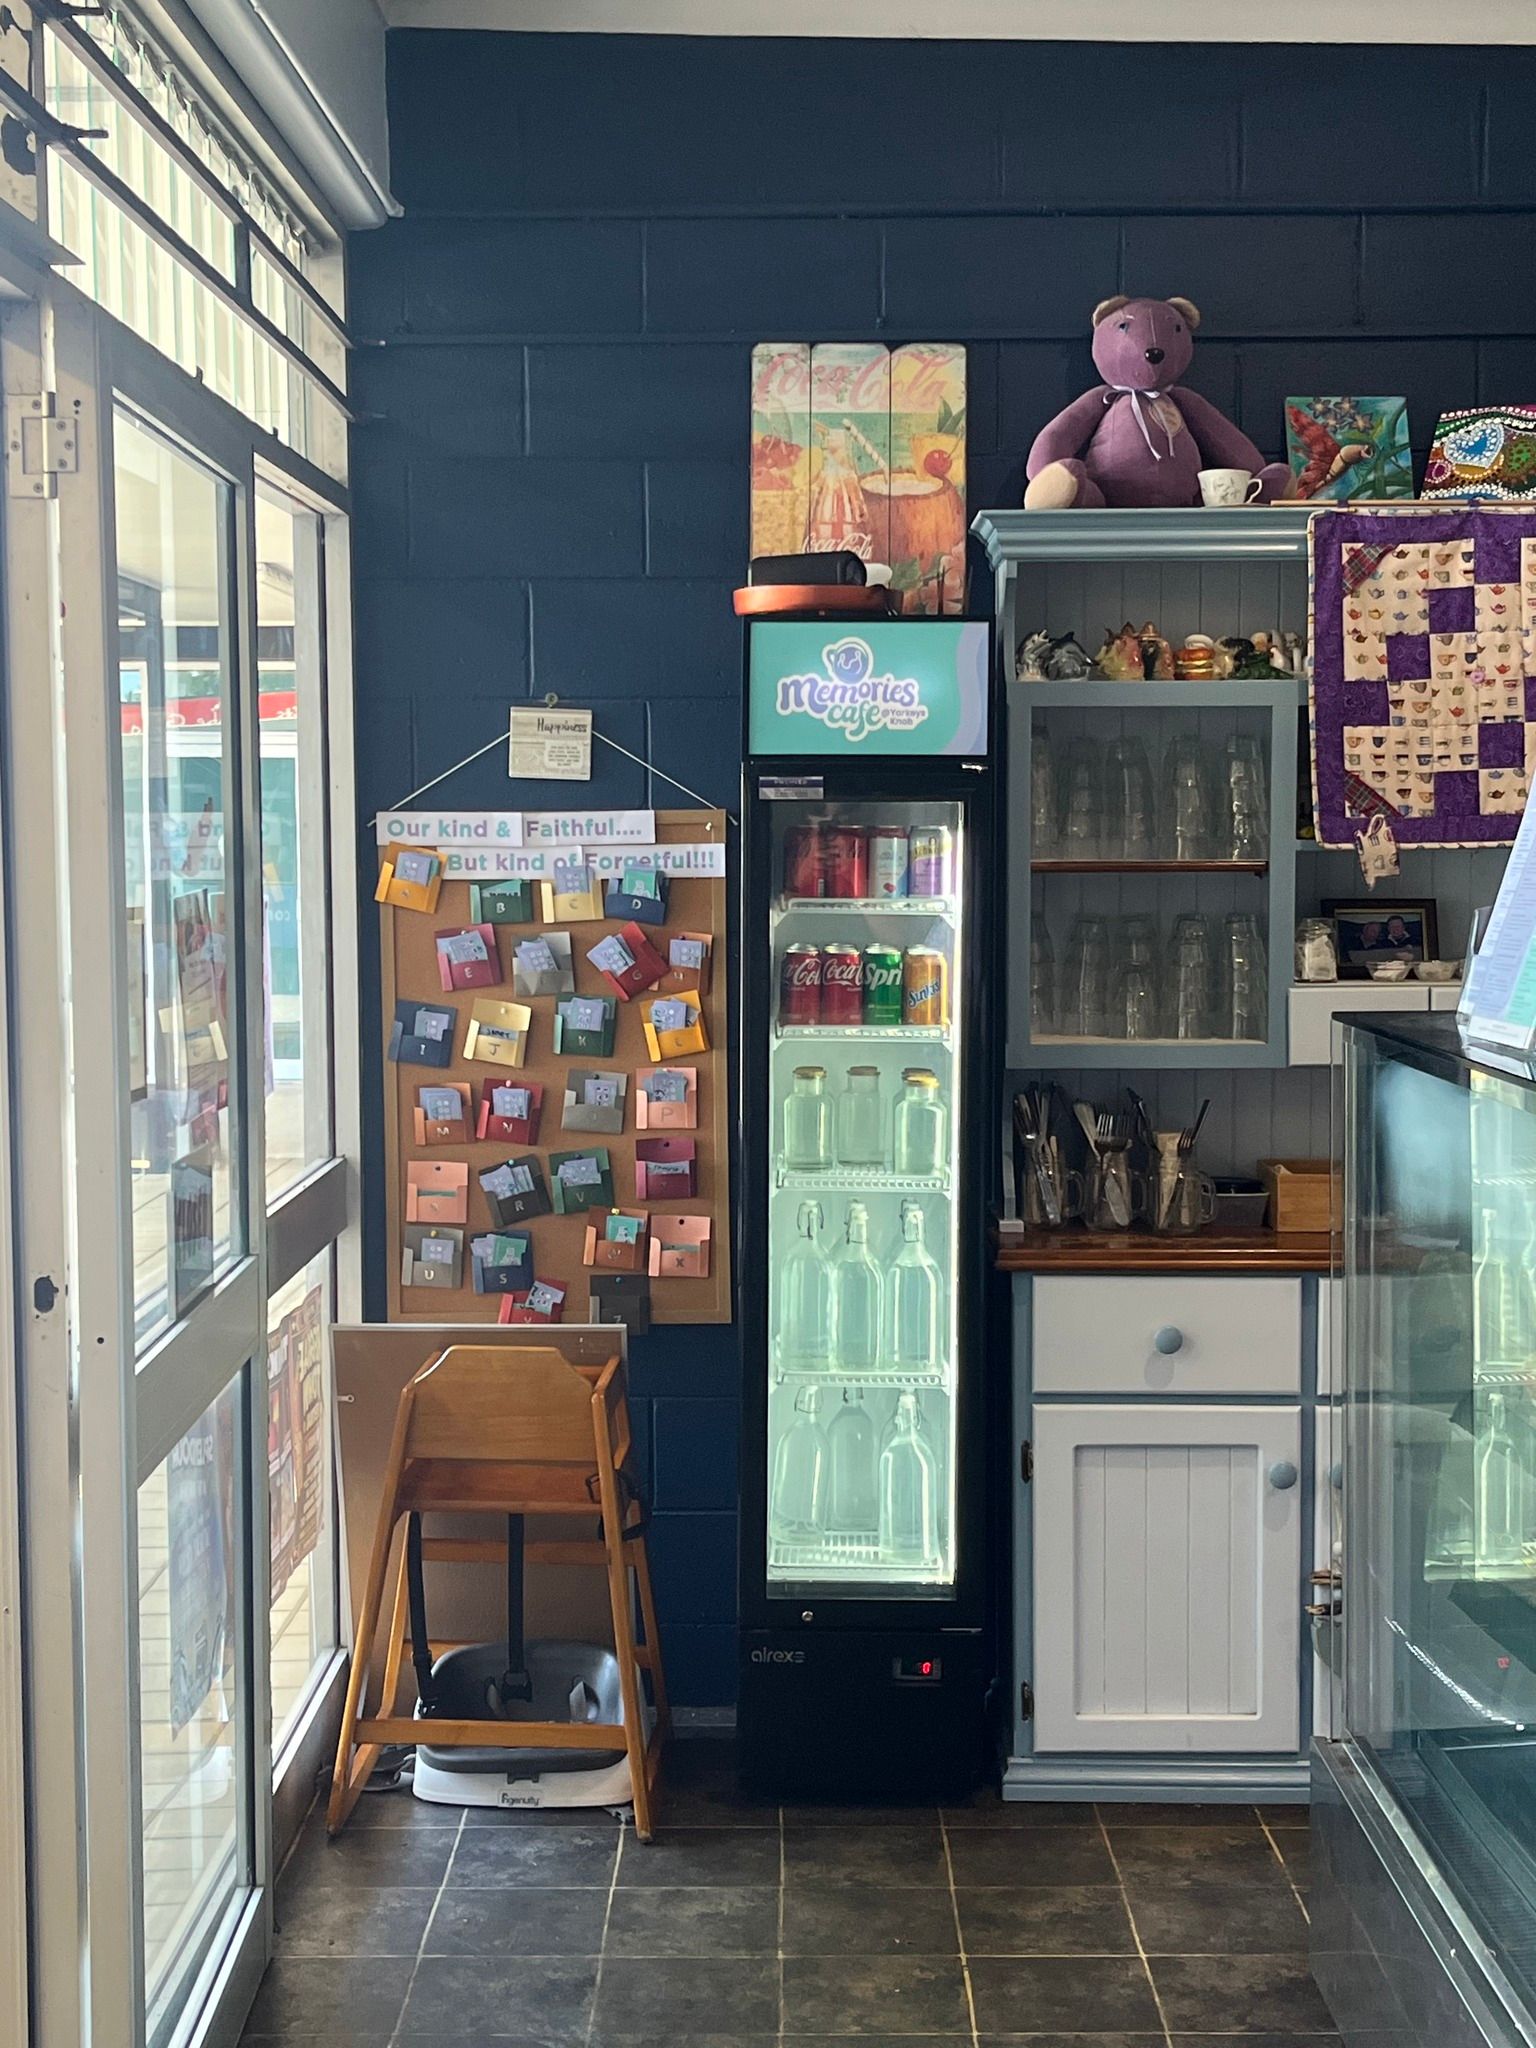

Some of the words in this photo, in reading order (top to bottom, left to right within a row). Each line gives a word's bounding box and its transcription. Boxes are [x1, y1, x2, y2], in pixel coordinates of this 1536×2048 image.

[780, 677, 915, 714] Memories
[827, 701, 881, 736] cafe
[537, 717, 587, 734] Happiness
[387, 819, 430, 837] Our
[438, 819, 488, 837] kind
[496, 820, 511, 837] &
[447, 854, 487, 871] But
[496, 853, 545, 871] kind
[554, 853, 578, 867] of
[496, 902, 506, 913] B
[632, 899, 642, 910] D
[578, 1035, 587, 1047] K
[489, 1043, 501, 1056] J
[661, 1107, 674, 1122] P
[515, 1201, 525, 1212] R
[675, 1258, 684, 1268] X
[424, 1269, 434, 1280] U
[500, 1274, 508, 1284] S
